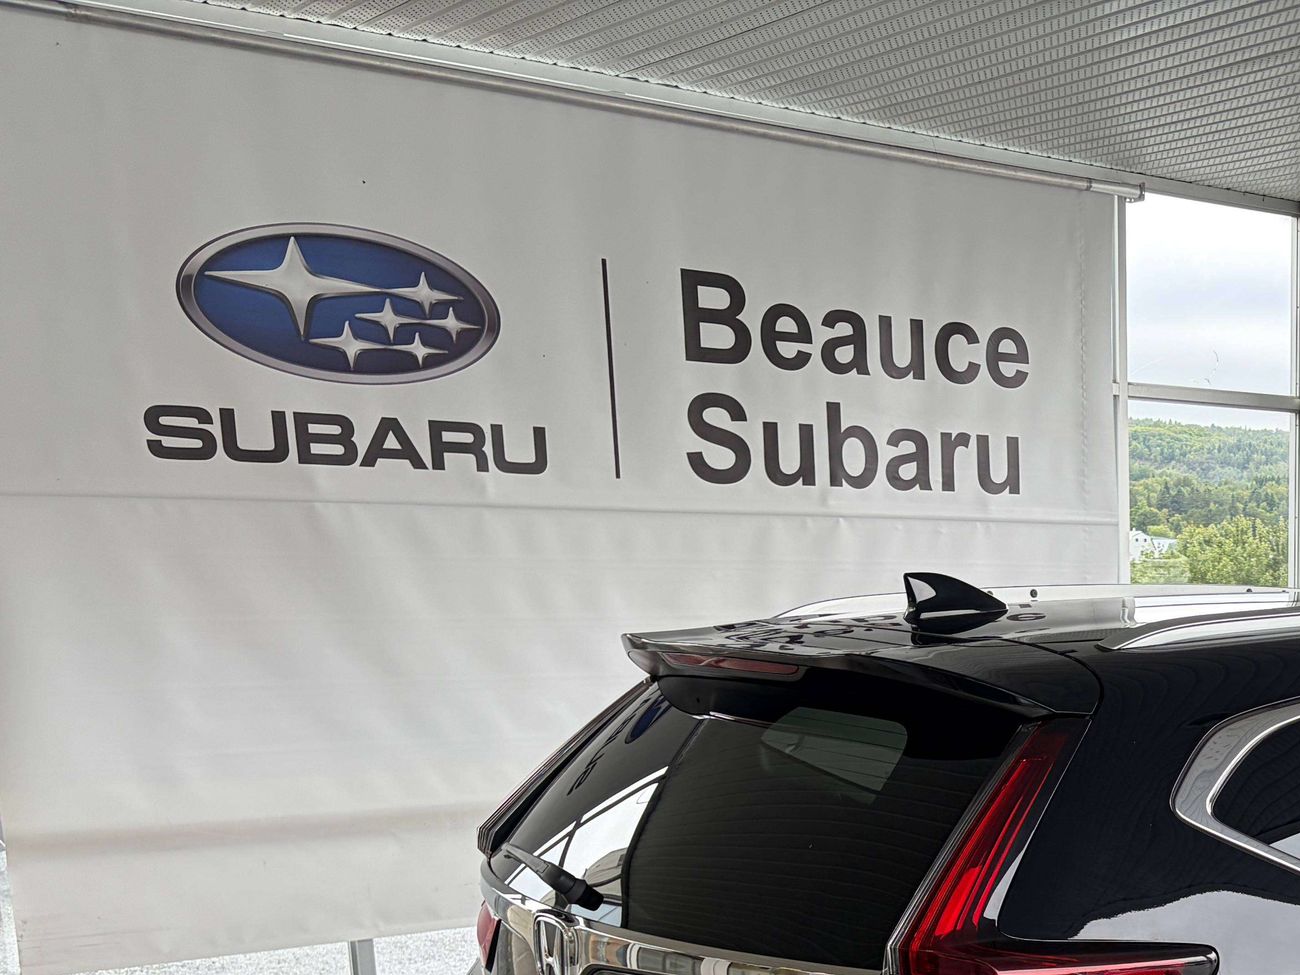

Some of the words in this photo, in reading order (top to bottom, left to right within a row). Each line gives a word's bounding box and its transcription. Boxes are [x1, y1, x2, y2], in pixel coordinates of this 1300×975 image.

[680, 267, 1030, 389] Beauce
[144, 404, 548, 475] SUBARU
[687, 392, 1021, 495] Subaru
